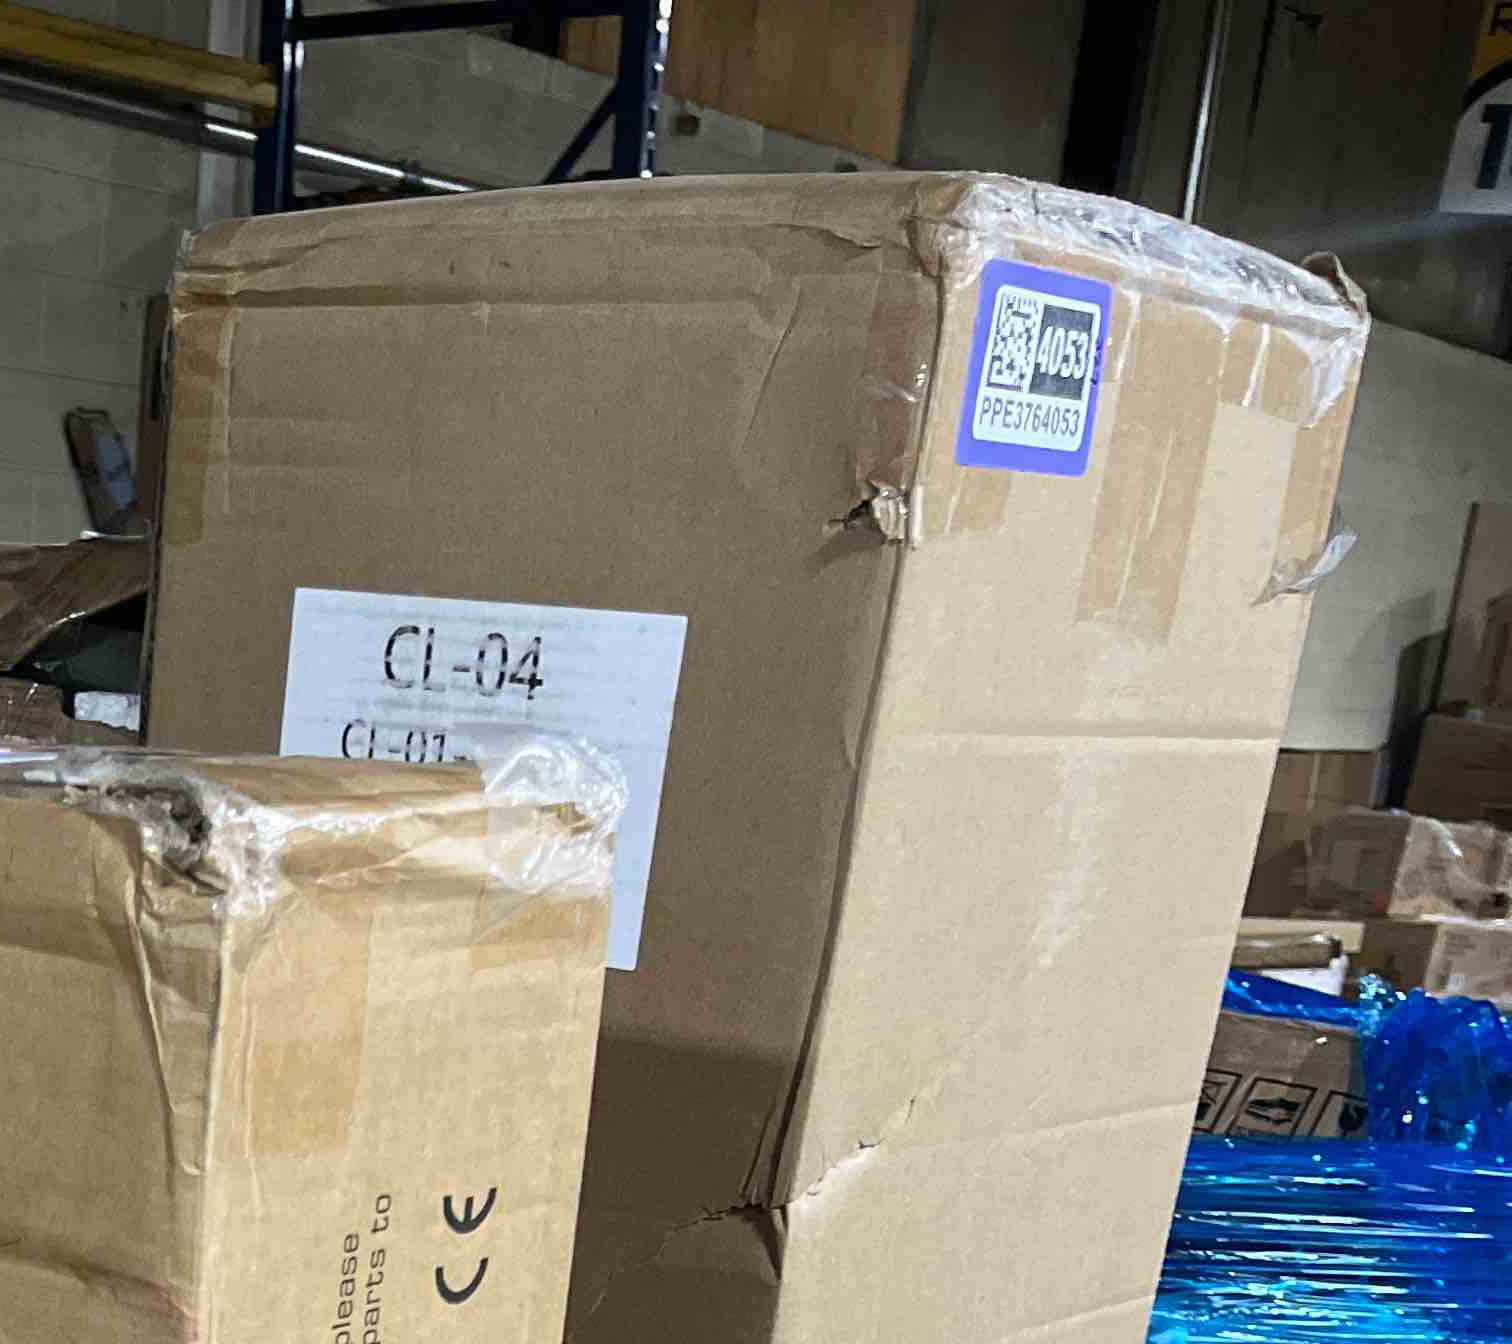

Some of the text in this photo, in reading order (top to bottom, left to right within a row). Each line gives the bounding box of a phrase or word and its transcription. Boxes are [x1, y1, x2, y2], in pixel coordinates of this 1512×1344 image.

[1036, 326, 1092, 381] 4053
[979, 395, 1081, 438] PPE3764053
[384, 624, 544, 701] CL-04
[371, 1193, 392, 1234] to
